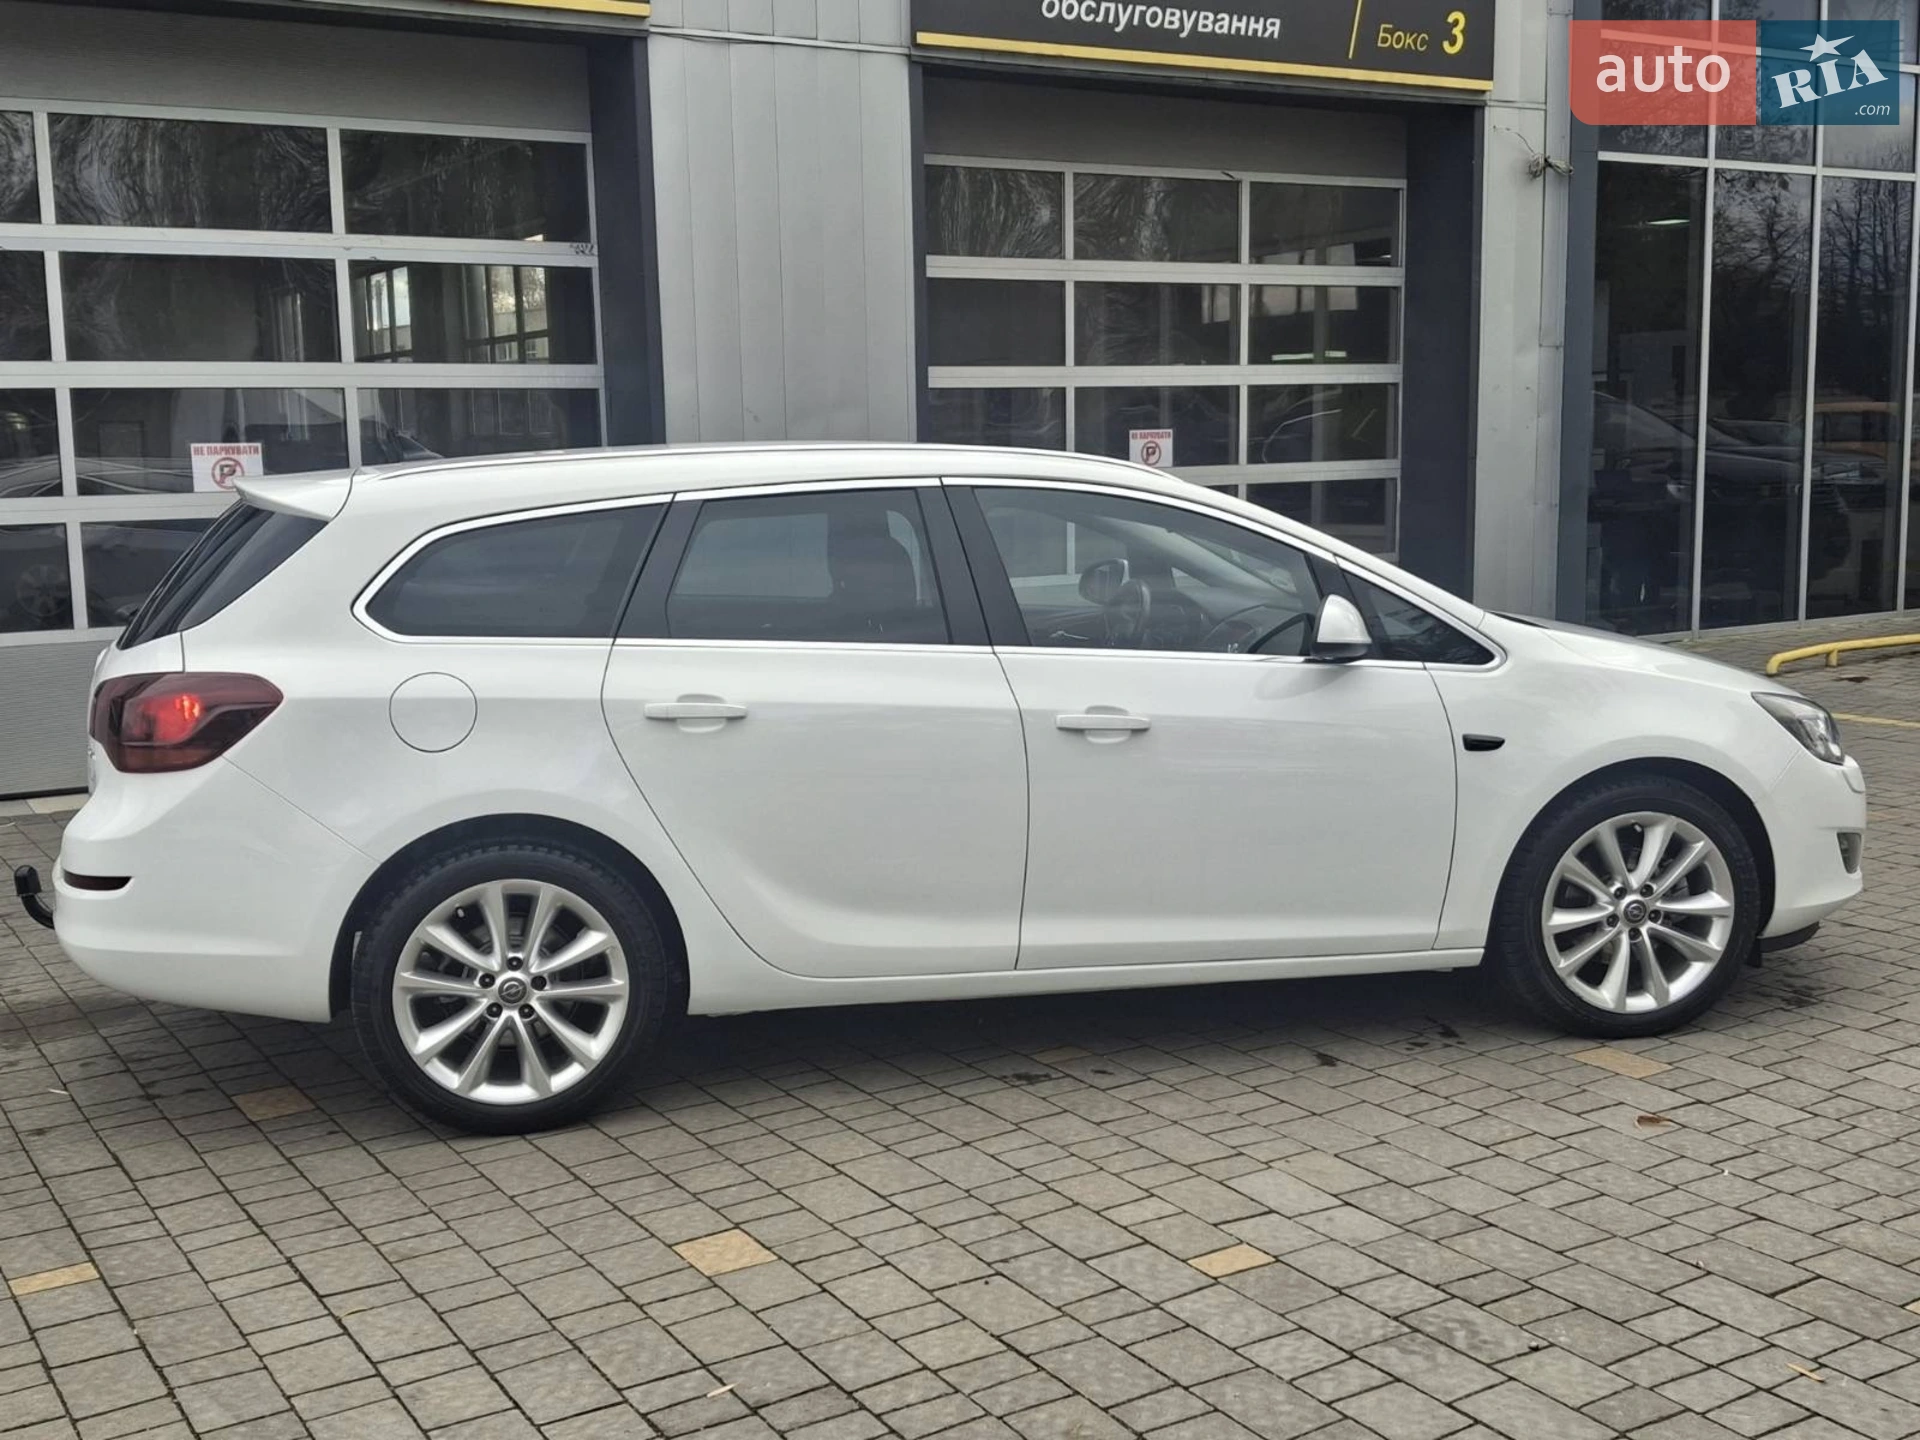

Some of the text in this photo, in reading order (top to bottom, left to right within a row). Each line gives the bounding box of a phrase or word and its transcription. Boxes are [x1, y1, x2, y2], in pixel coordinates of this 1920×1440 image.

[1041, 0, 1281, 39] обслуговування
[1377, 10, 1466, 55] Бокс 3
[193, 445, 206, 456] НЕ
